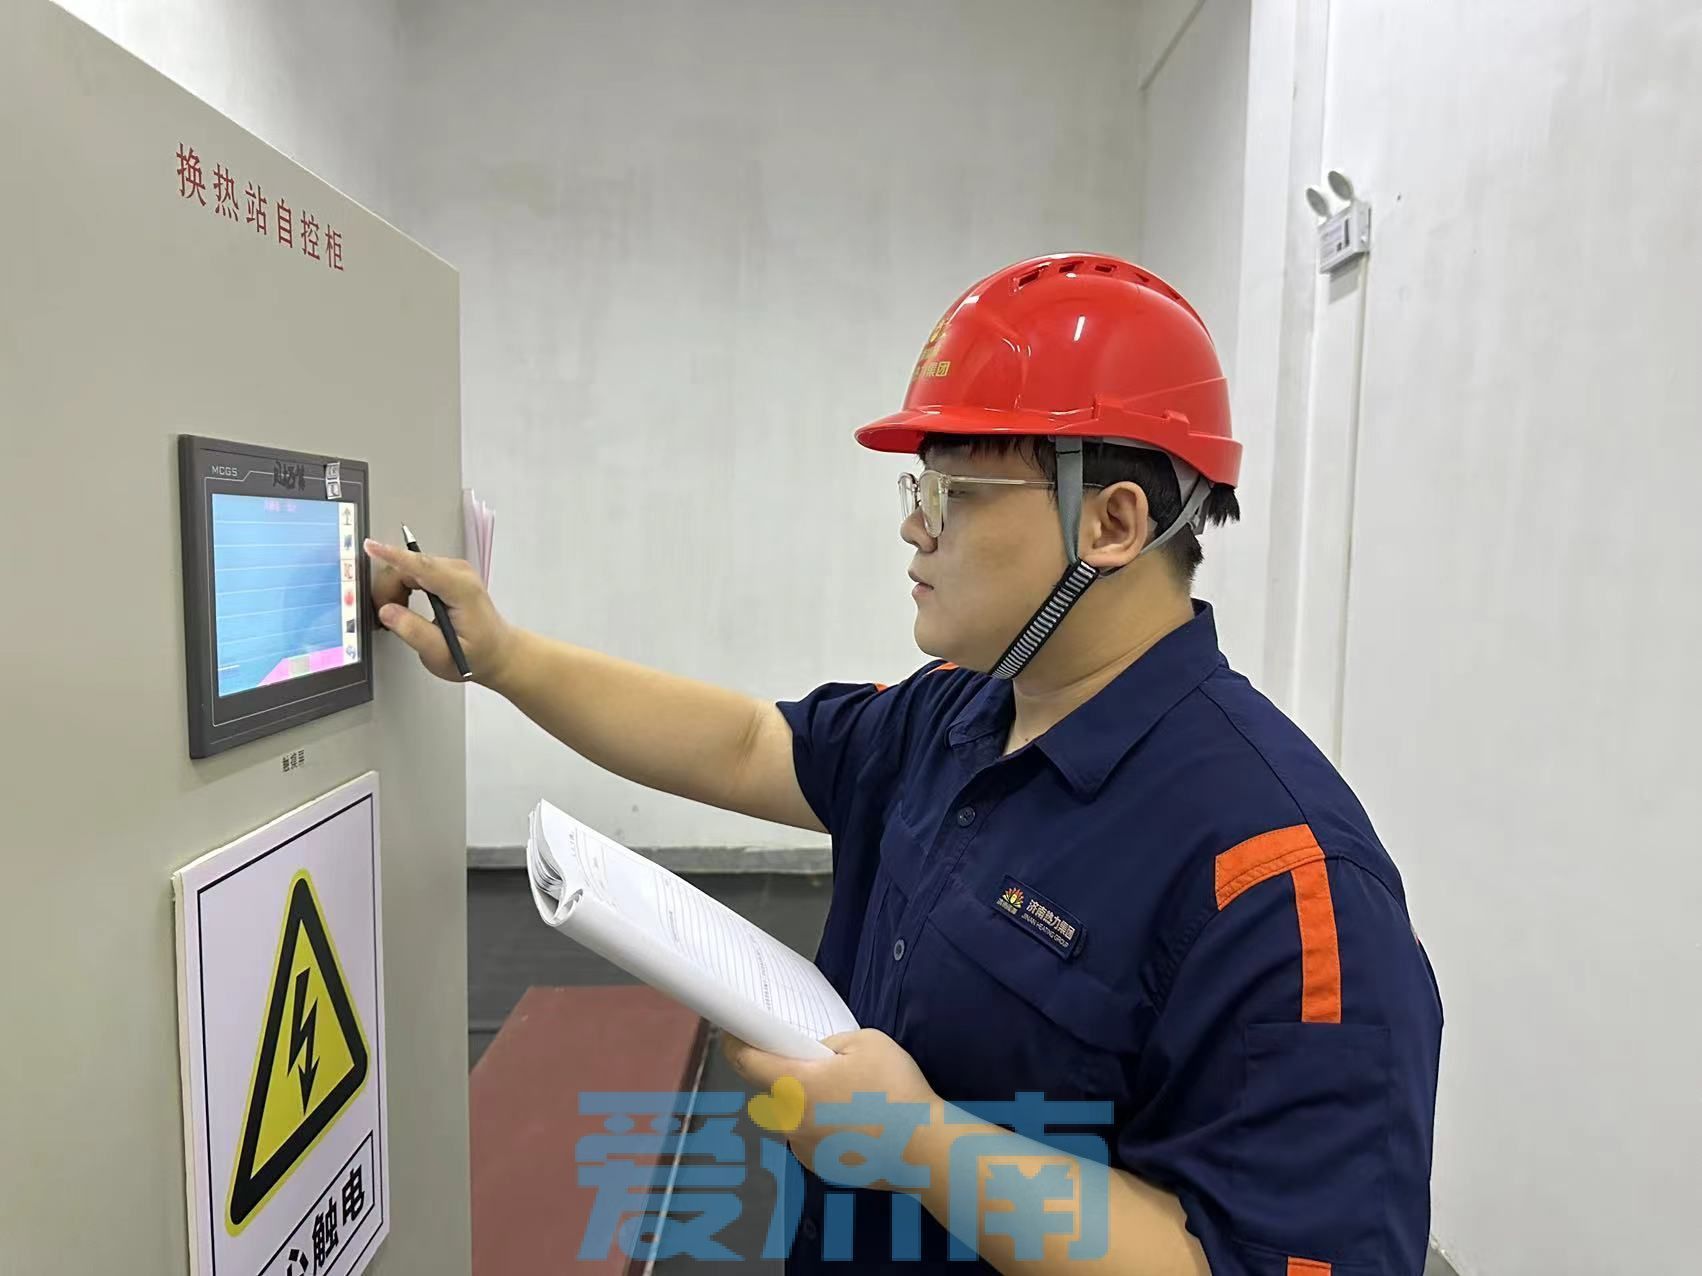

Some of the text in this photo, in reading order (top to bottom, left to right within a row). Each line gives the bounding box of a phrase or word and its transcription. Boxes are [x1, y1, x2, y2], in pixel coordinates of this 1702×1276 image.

[176, 142, 344, 271] 换热站自控柜
[211, 465, 238, 477] MCGS
[1026, 899, 1076, 941] 济南热力集团
